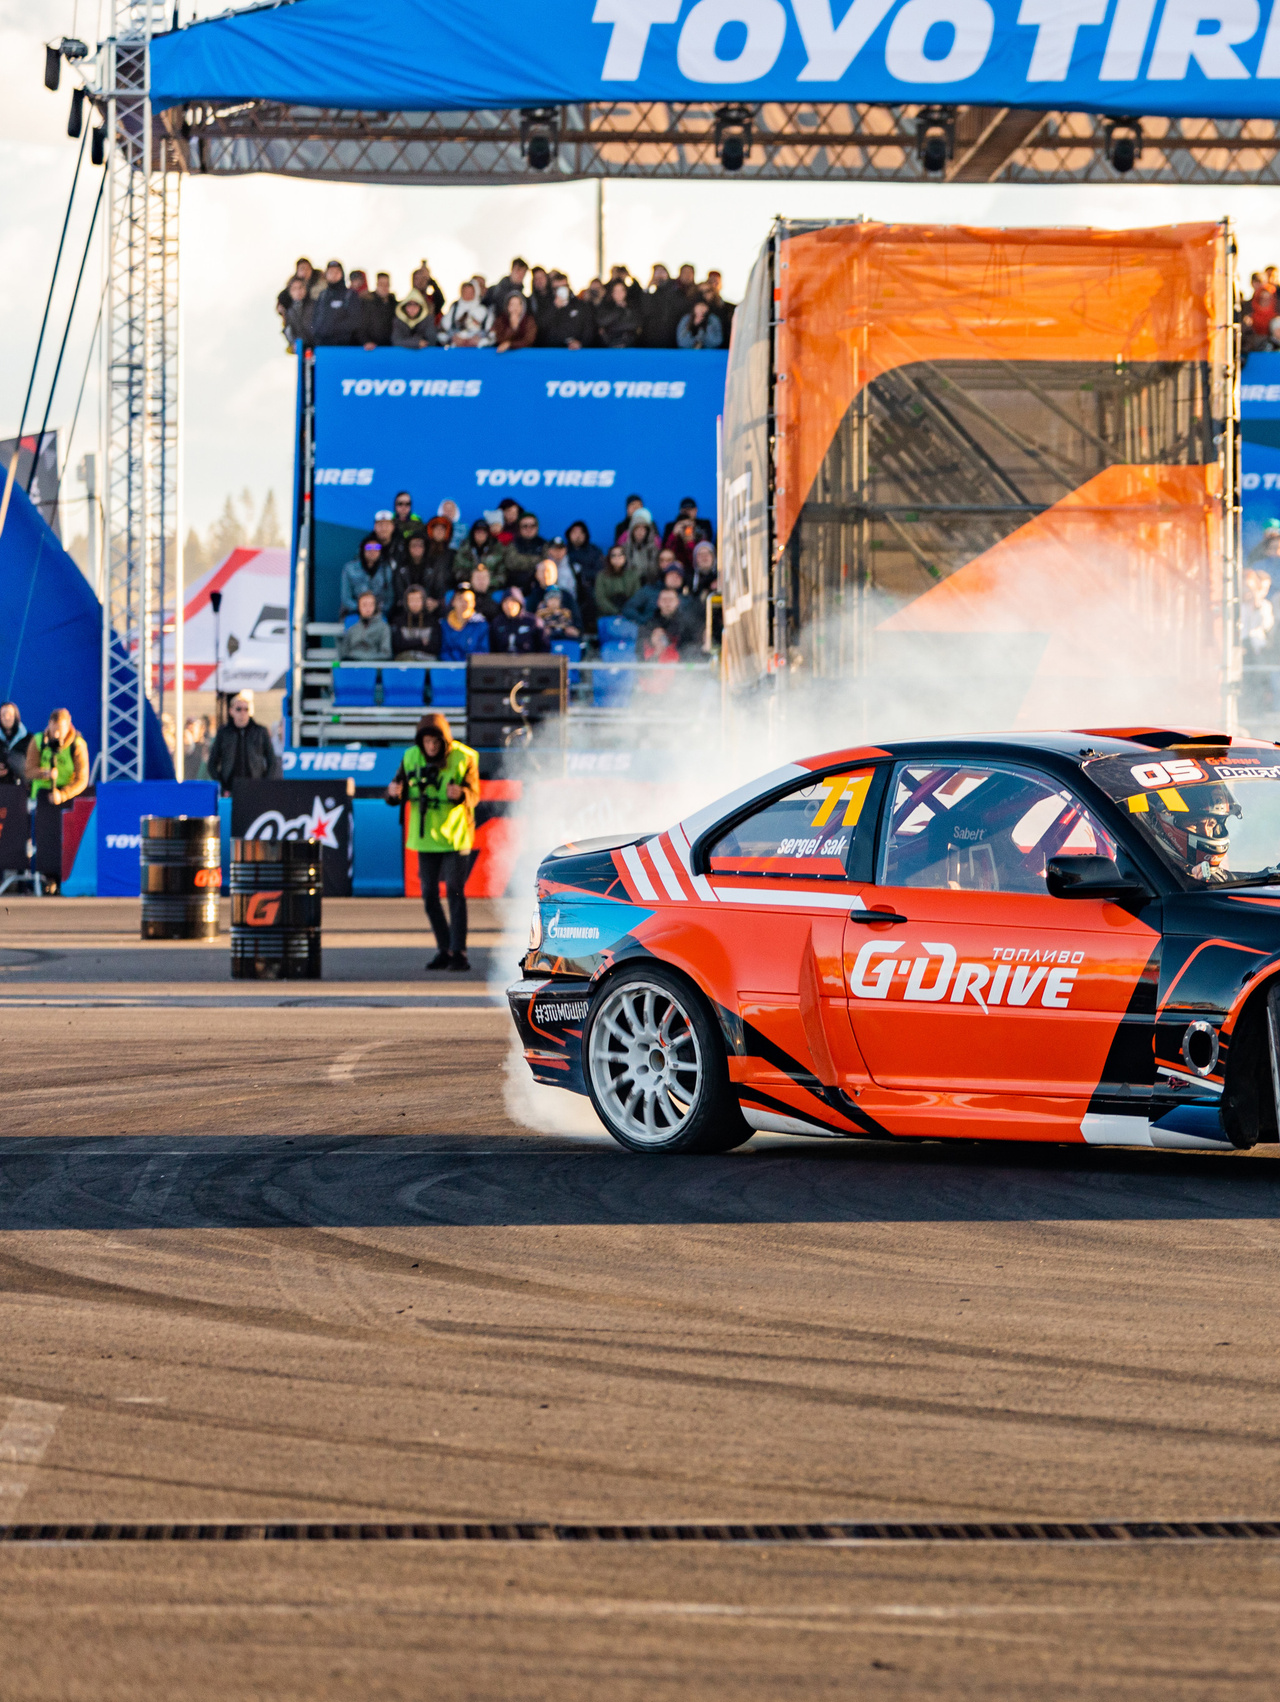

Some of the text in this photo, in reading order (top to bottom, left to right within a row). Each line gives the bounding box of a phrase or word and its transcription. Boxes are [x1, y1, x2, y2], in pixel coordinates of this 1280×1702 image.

[592, 0, 996, 84] TOYO
[341, 379, 482, 397] TOYO TIRES
[546, 381, 686, 398] TOYO TIRES
[314, 468, 374, 486] IRES
[475, 469, 616, 487] TOYO TIRES
[299, 751, 377, 771] TIRES
[567, 752, 632, 770] IRES
[1130, 759, 1205, 788] 05
[811, 775, 874, 827] 71
[105, 834, 143, 848] TOY
[953, 826, 985, 840] Sabelt
[777, 835, 848, 858] sergei sak
[992, 947, 1085, 964] ТОПЛИВО
